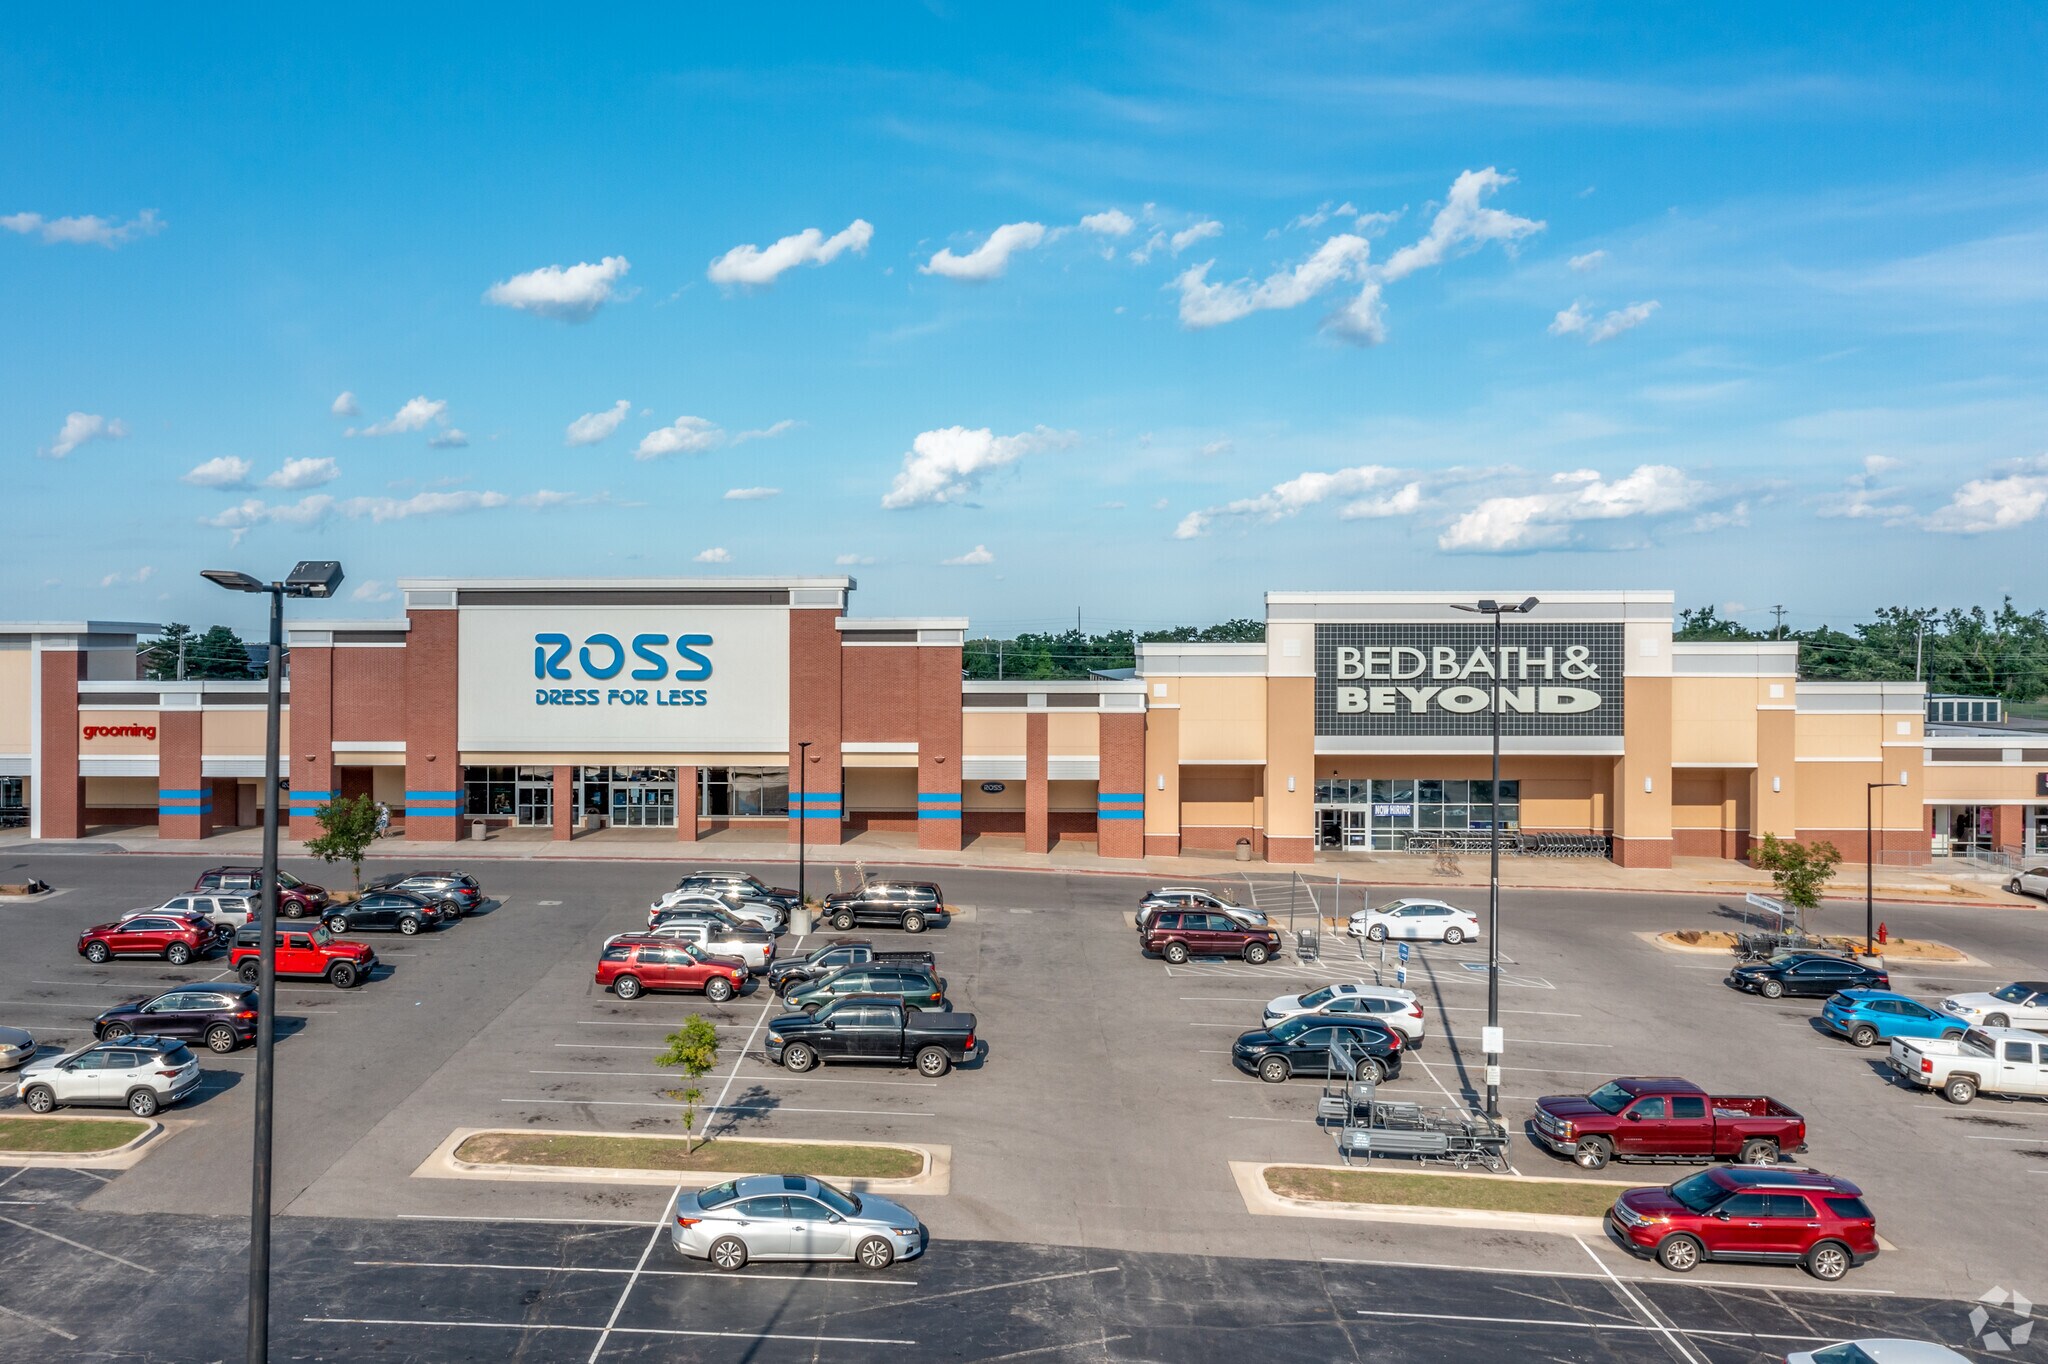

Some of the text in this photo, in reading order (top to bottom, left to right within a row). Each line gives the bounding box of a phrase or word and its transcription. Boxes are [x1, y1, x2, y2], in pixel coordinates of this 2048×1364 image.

[535, 633, 713, 681] ROSS
[1337, 645, 1601, 680] BED BATH &
[536, 689, 707, 706] DRESS FOR LESS
[1337, 686, 1602, 714] BEYOND
[83, 722, 156, 740] grooming
[1375, 805, 1410, 815] NOW HIRING
